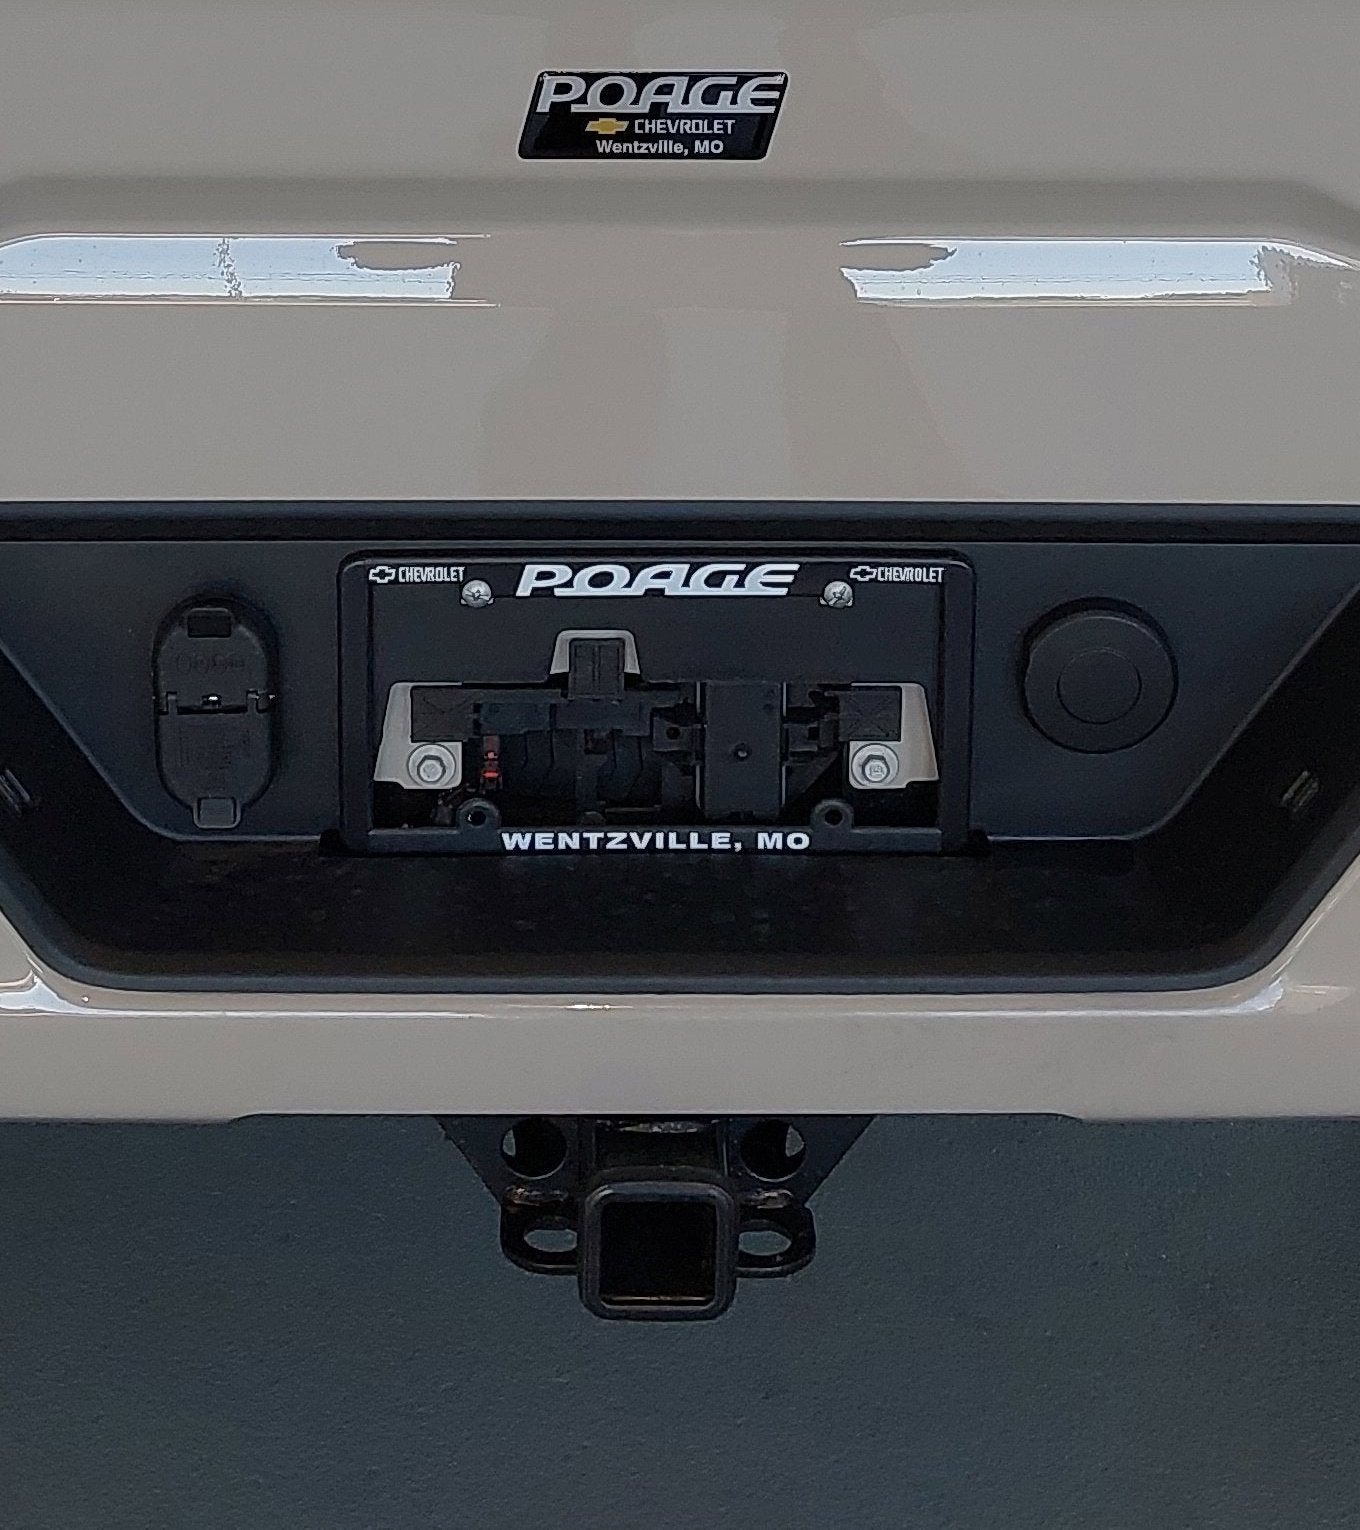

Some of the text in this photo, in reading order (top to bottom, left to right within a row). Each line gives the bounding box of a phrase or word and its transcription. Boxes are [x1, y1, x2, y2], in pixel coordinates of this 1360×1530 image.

[536, 75, 784, 113] POAGE
[634, 119, 736, 134] CHEVROLET
[596, 139, 724, 156] Wentzville, MO
[398, 566, 465, 582] CHEVROLET
[515, 564, 800, 596] POAGE
[876, 567, 944, 582] CHEVROLET
[501, 832, 810, 852] WENTZVILLE, MO
